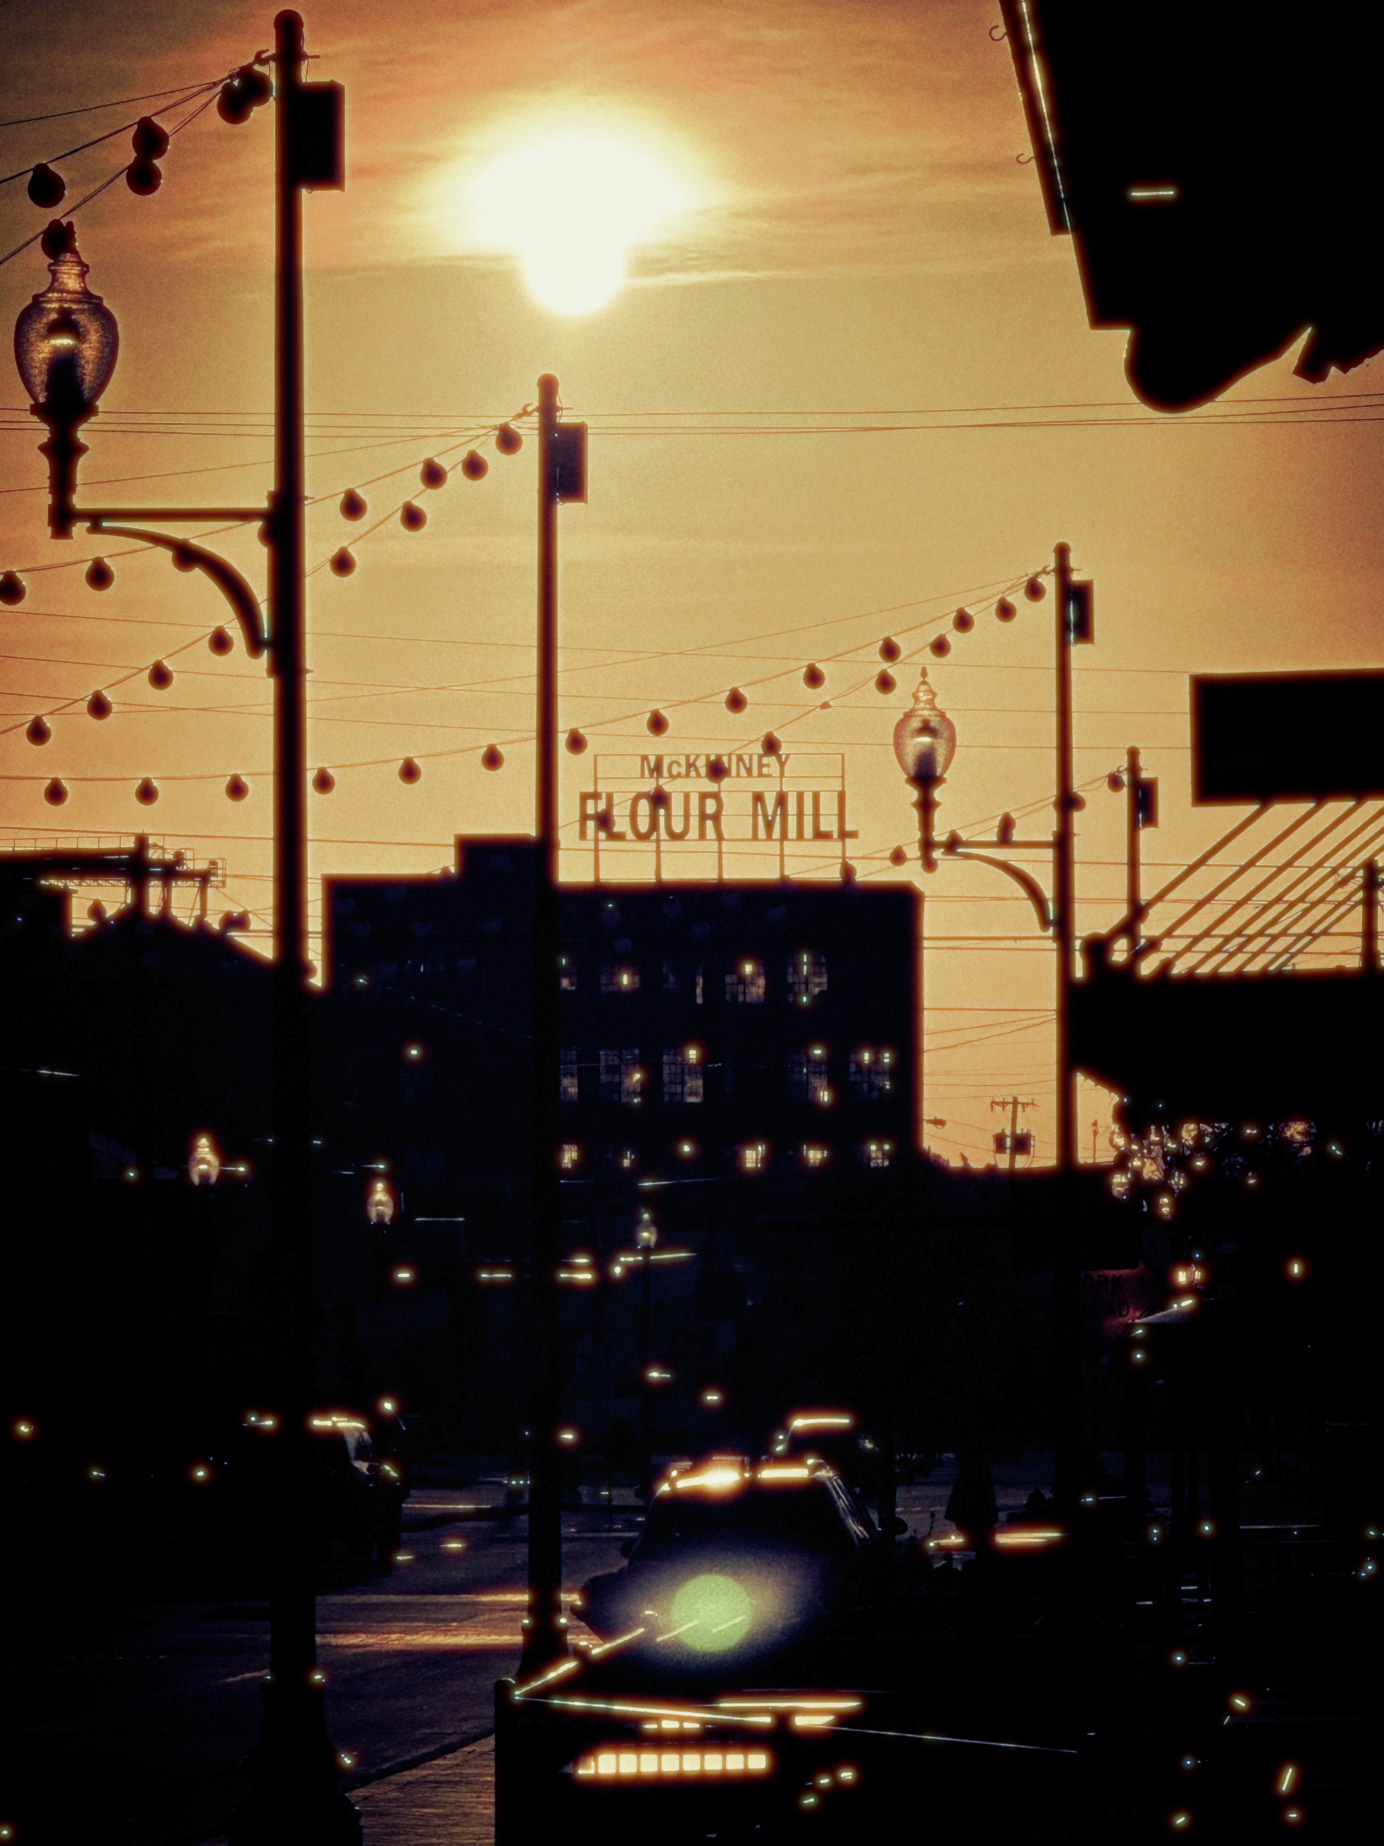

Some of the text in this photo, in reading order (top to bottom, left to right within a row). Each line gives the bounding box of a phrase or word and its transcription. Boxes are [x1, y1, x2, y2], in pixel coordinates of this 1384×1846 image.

[579, 791, 859, 841] FLOUR MILL
[1083, 1274, 1124, 1290] ORK
